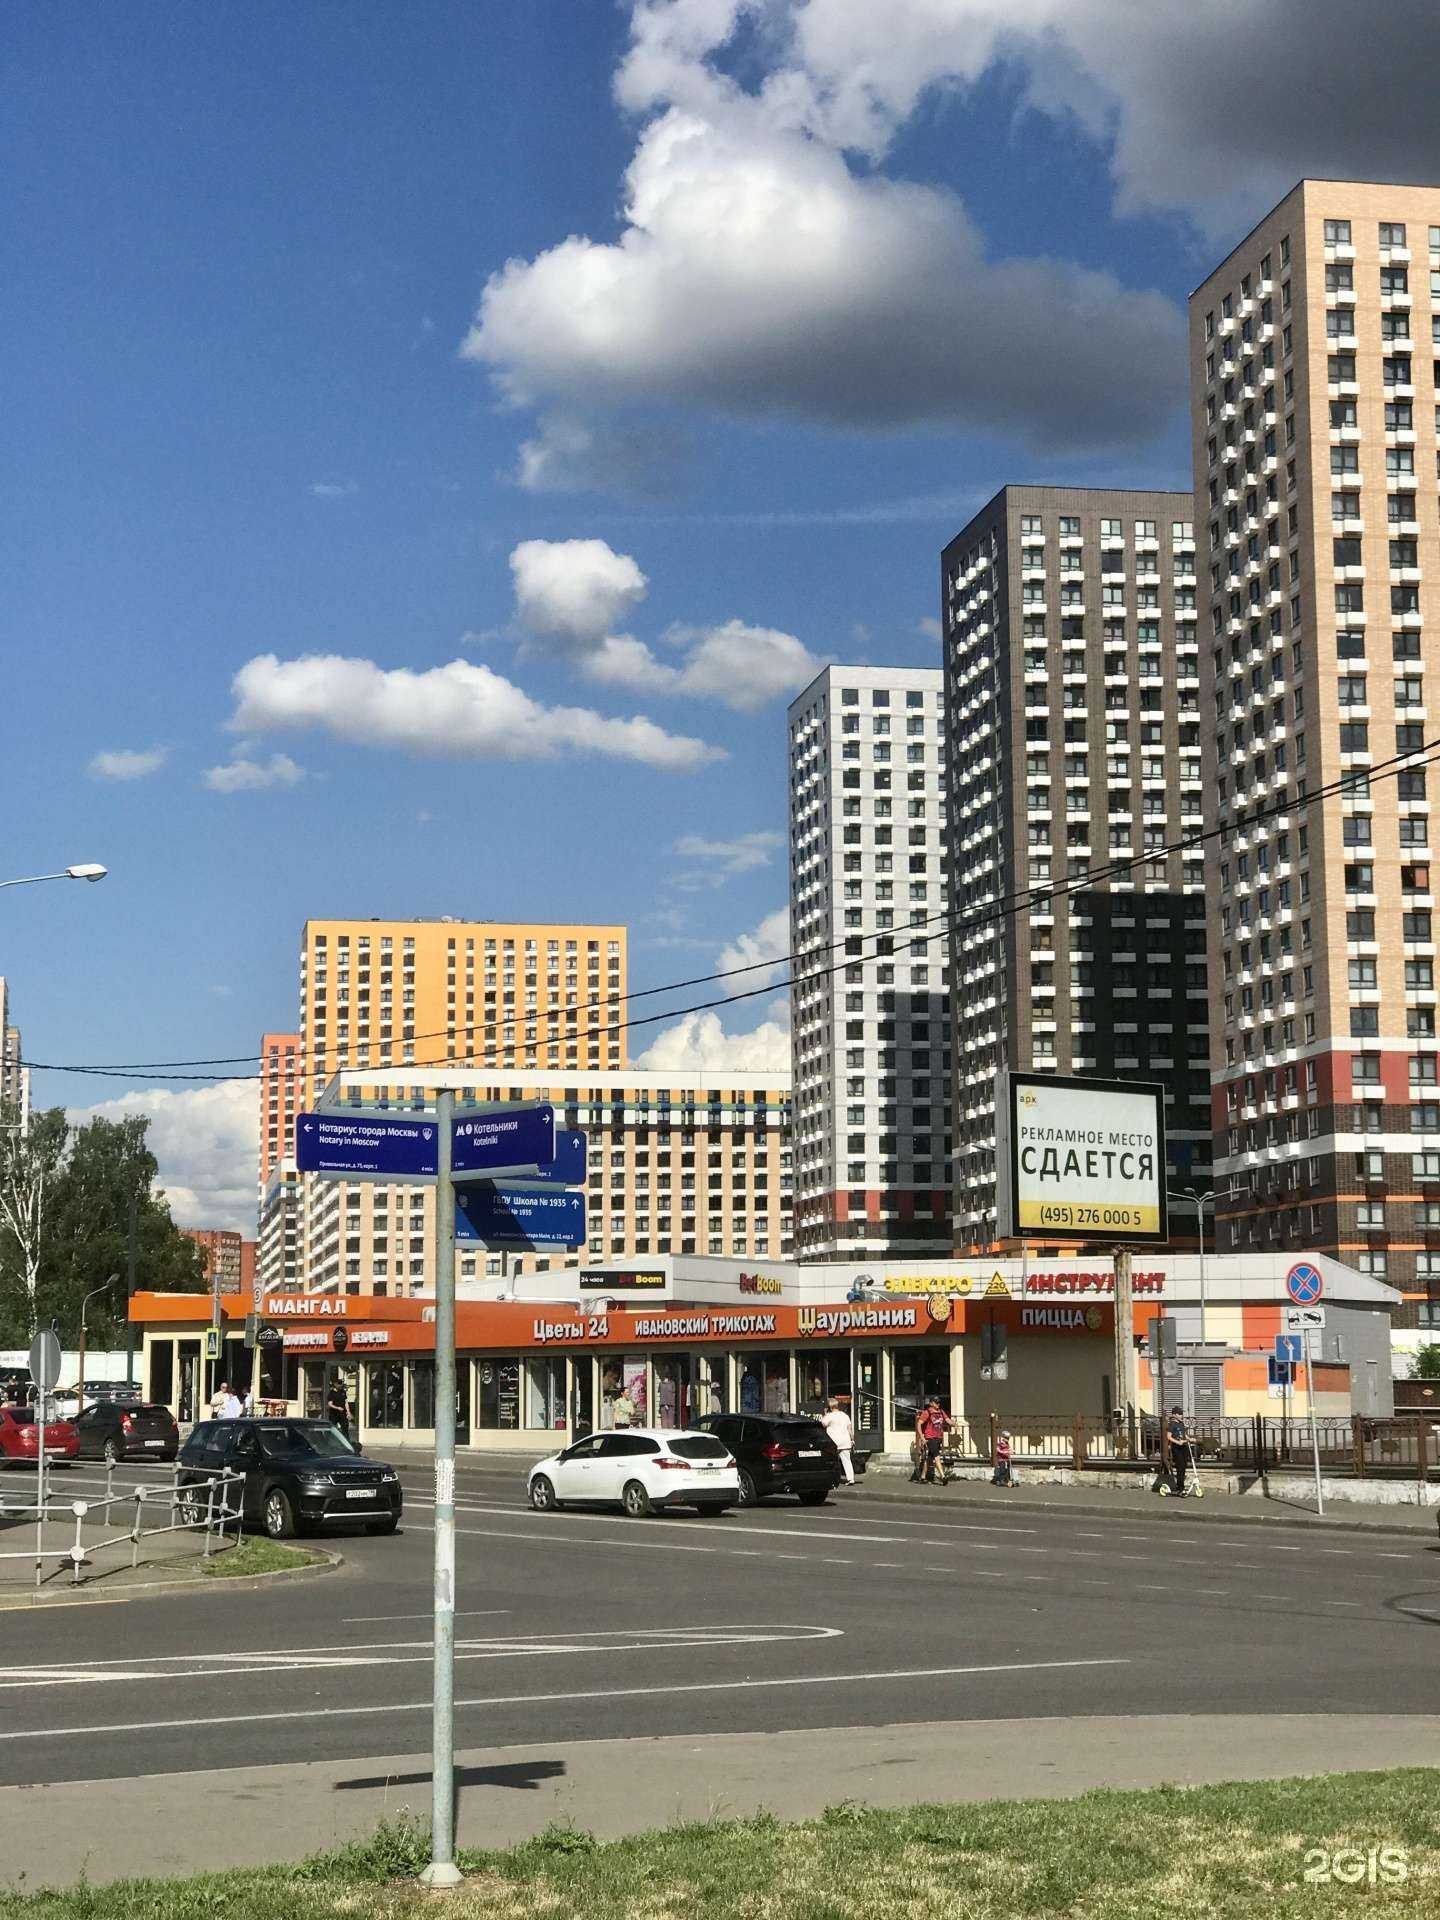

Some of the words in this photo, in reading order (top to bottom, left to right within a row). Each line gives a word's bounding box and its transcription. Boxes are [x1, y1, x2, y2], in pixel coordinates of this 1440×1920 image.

[319, 1123, 356, 1136] Нотариус
[358, 1127, 386, 1137] города
[387, 1128, 418, 1138] Москвы
[473, 1121, 518, 1134] Котельники
[1021, 1126, 1104, 1144] РЕКЛАМНОЕ
[1109, 1132, 1153, 1147] МЕСТО
[319, 1136, 343, 1146] Notary
[352, 1138, 380, 1147] Moscow
[473, 1136, 498, 1146] Kotelniki
[1021, 1146, 1153, 1182] СДАЕТСЯ
[513, 1196, 538, 1206] Школа
[539, 1197, 549, 1206] №
[549, 1198, 567, 1208] 1935
[519, 1208, 532, 1216] 1935
[1040, 1205, 1073, 1226] (495)
[1077, 1208, 1100, 1224] 276
[1103, 1209, 1130, 1224] 000
[1133, 1211, 1141, 1225] 5
[580, 1276, 589, 1284] 24
[739, 1272, 783, 1295] BetBoom
[884, 1275, 974, 1296] ЭЛЕКТРО
[1026, 1272, 1166, 1294] ИНСТРУЕНТ
[268, 1299, 347, 1314] МАНГАЛ
[634, 1314, 709, 1336] ИВАНОВСКИЙ
[711, 1314, 776, 1333] ТРИКОТАЖ
[798, 1307, 916, 1335] Шаурмания
[1022, 1308, 1085, 1329] ПИЦЦА
[533, 1319, 584, 1342] Цветы
[588, 1317, 609, 1337] 24
